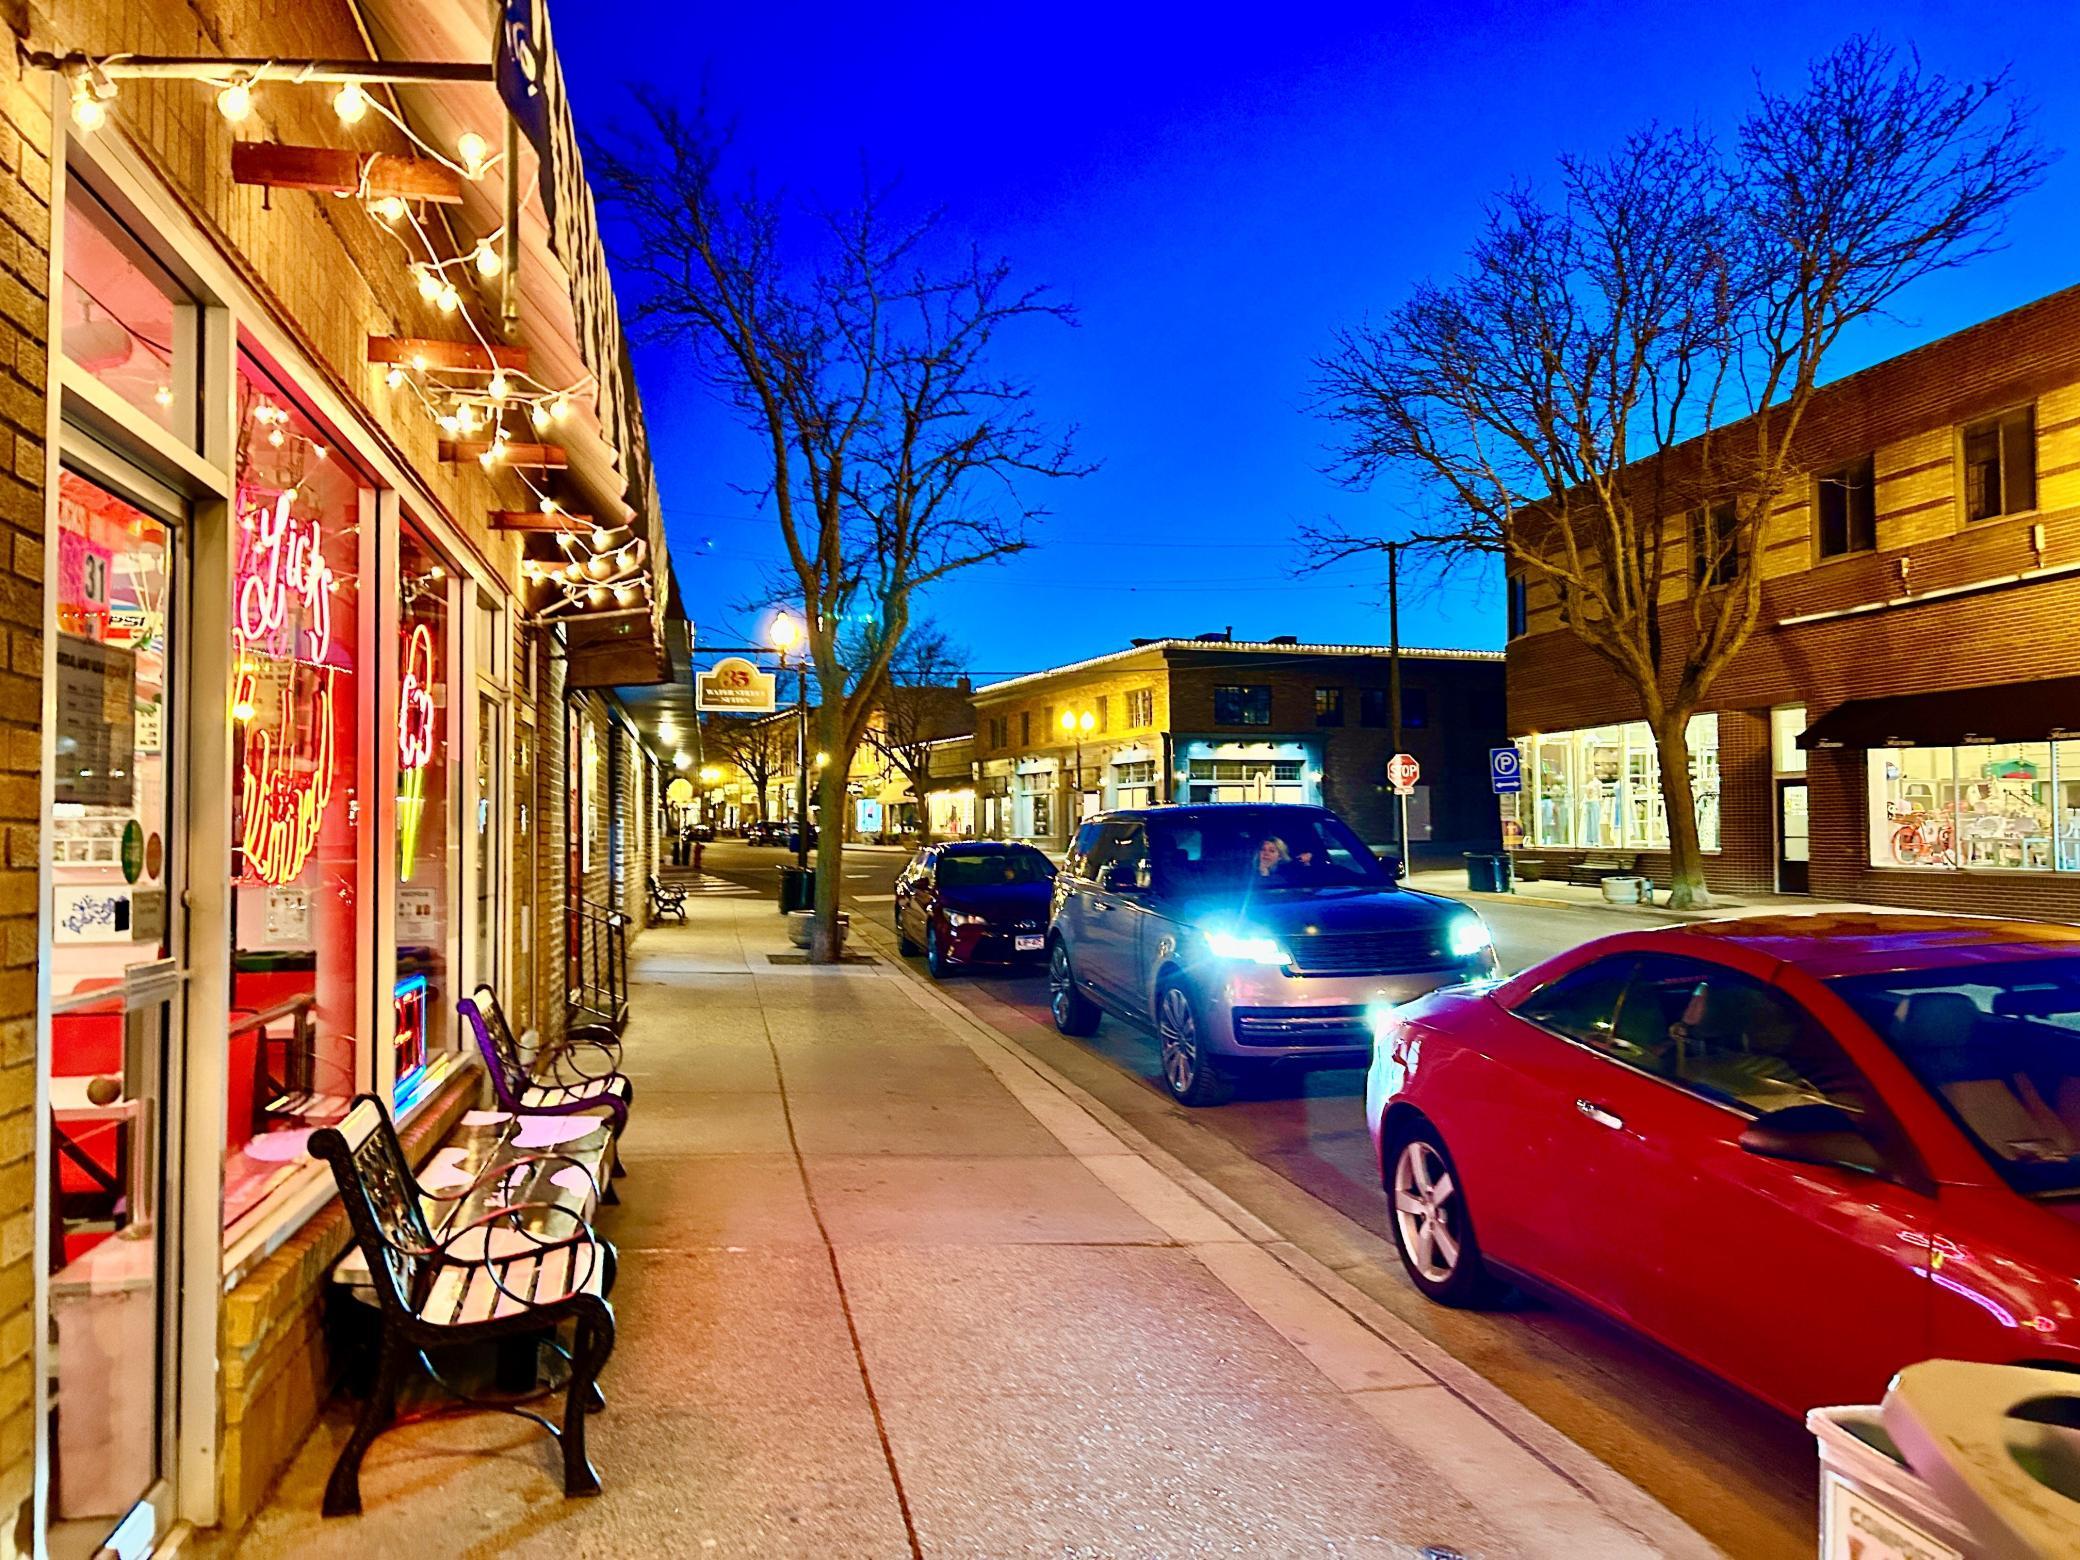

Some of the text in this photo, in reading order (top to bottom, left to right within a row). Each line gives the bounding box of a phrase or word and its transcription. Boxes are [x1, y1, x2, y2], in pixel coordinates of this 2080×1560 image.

[85, 554, 105, 603] 31
[240, 495, 333, 663] Licks
[1389, 764, 1417, 778] STOP
[1500, 756, 1512, 770] P
